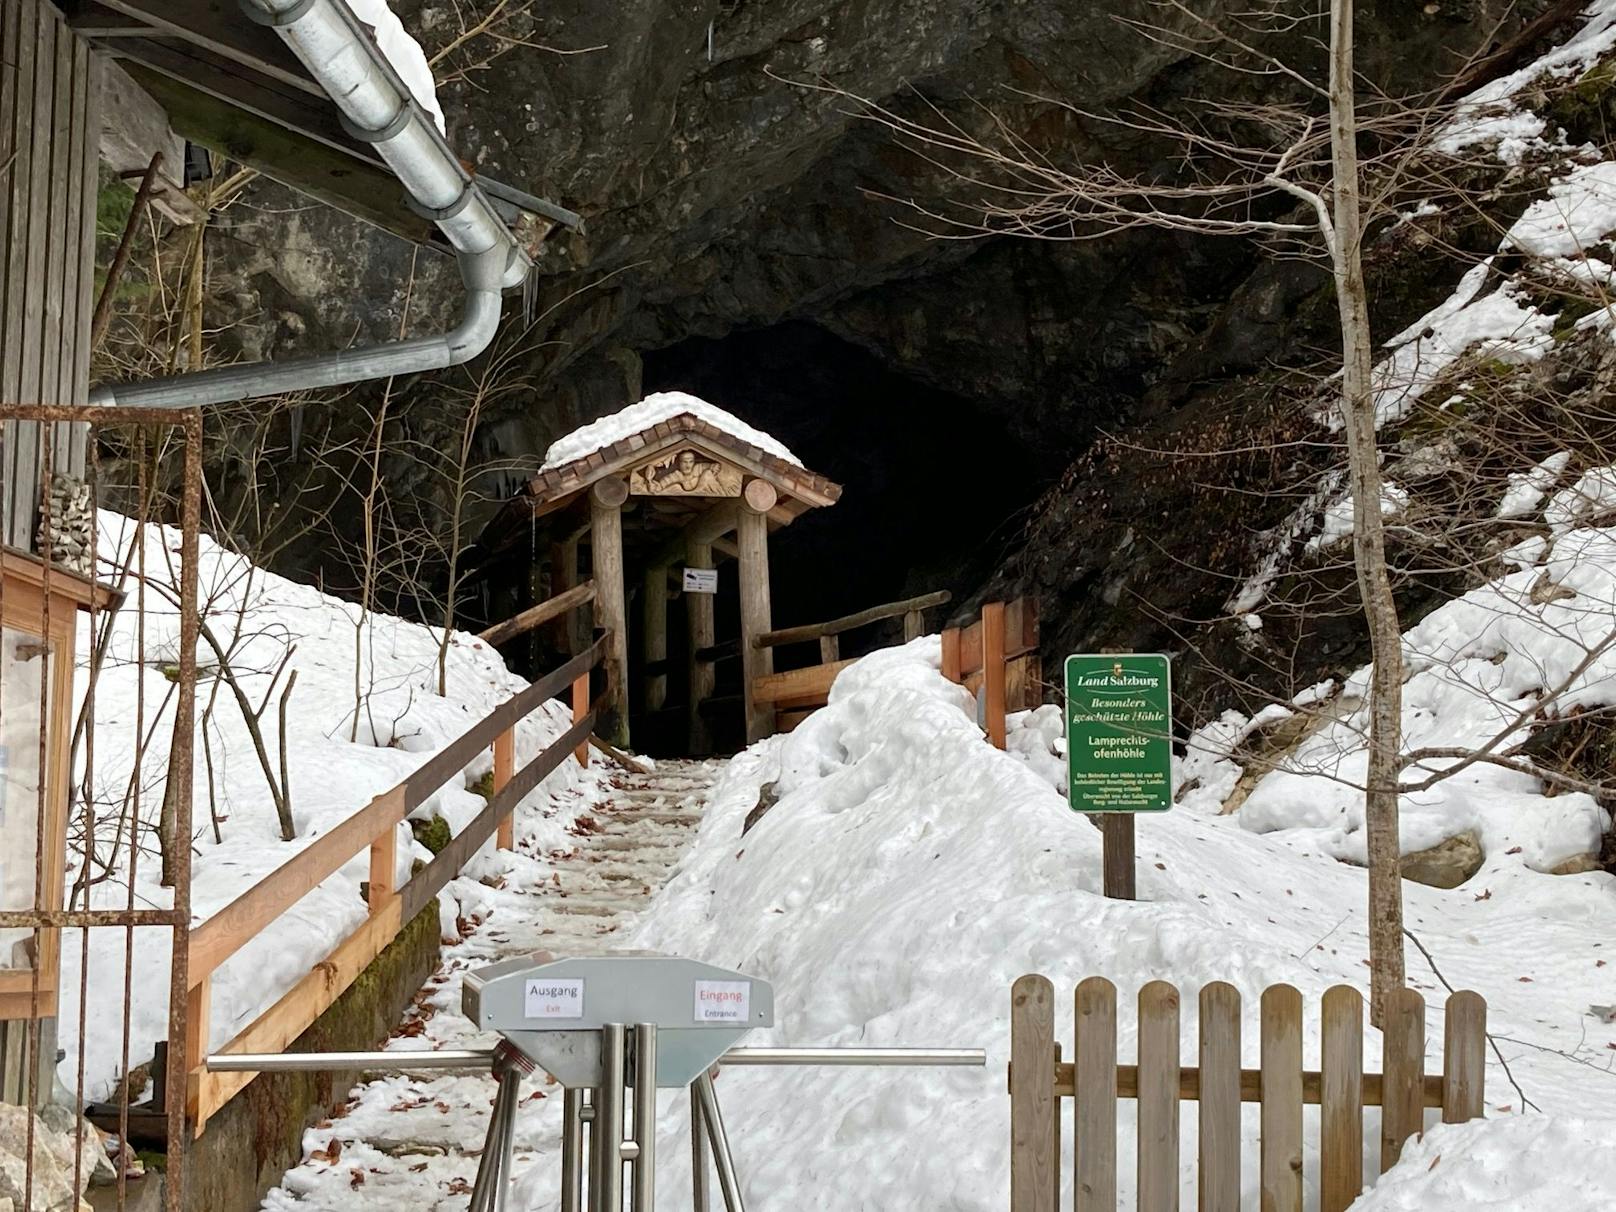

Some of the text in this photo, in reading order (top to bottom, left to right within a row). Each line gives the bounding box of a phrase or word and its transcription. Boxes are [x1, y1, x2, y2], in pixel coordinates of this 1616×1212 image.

[1078, 676, 1159, 688] Land Salzburg
[1091, 698, 1146, 708] Besonders
[1073, 711, 1165, 724] geschützte Höhle
[1088, 735, 1150, 748] Lamprechts-
[1093, 748, 1146, 759] ofenhöhle
[530, 985, 578, 998] Ausgang
[700, 990, 743, 1003] Eingang
[546, 1004, 561, 1013] Exit
[704, 1009, 738, 1018] Entrance
